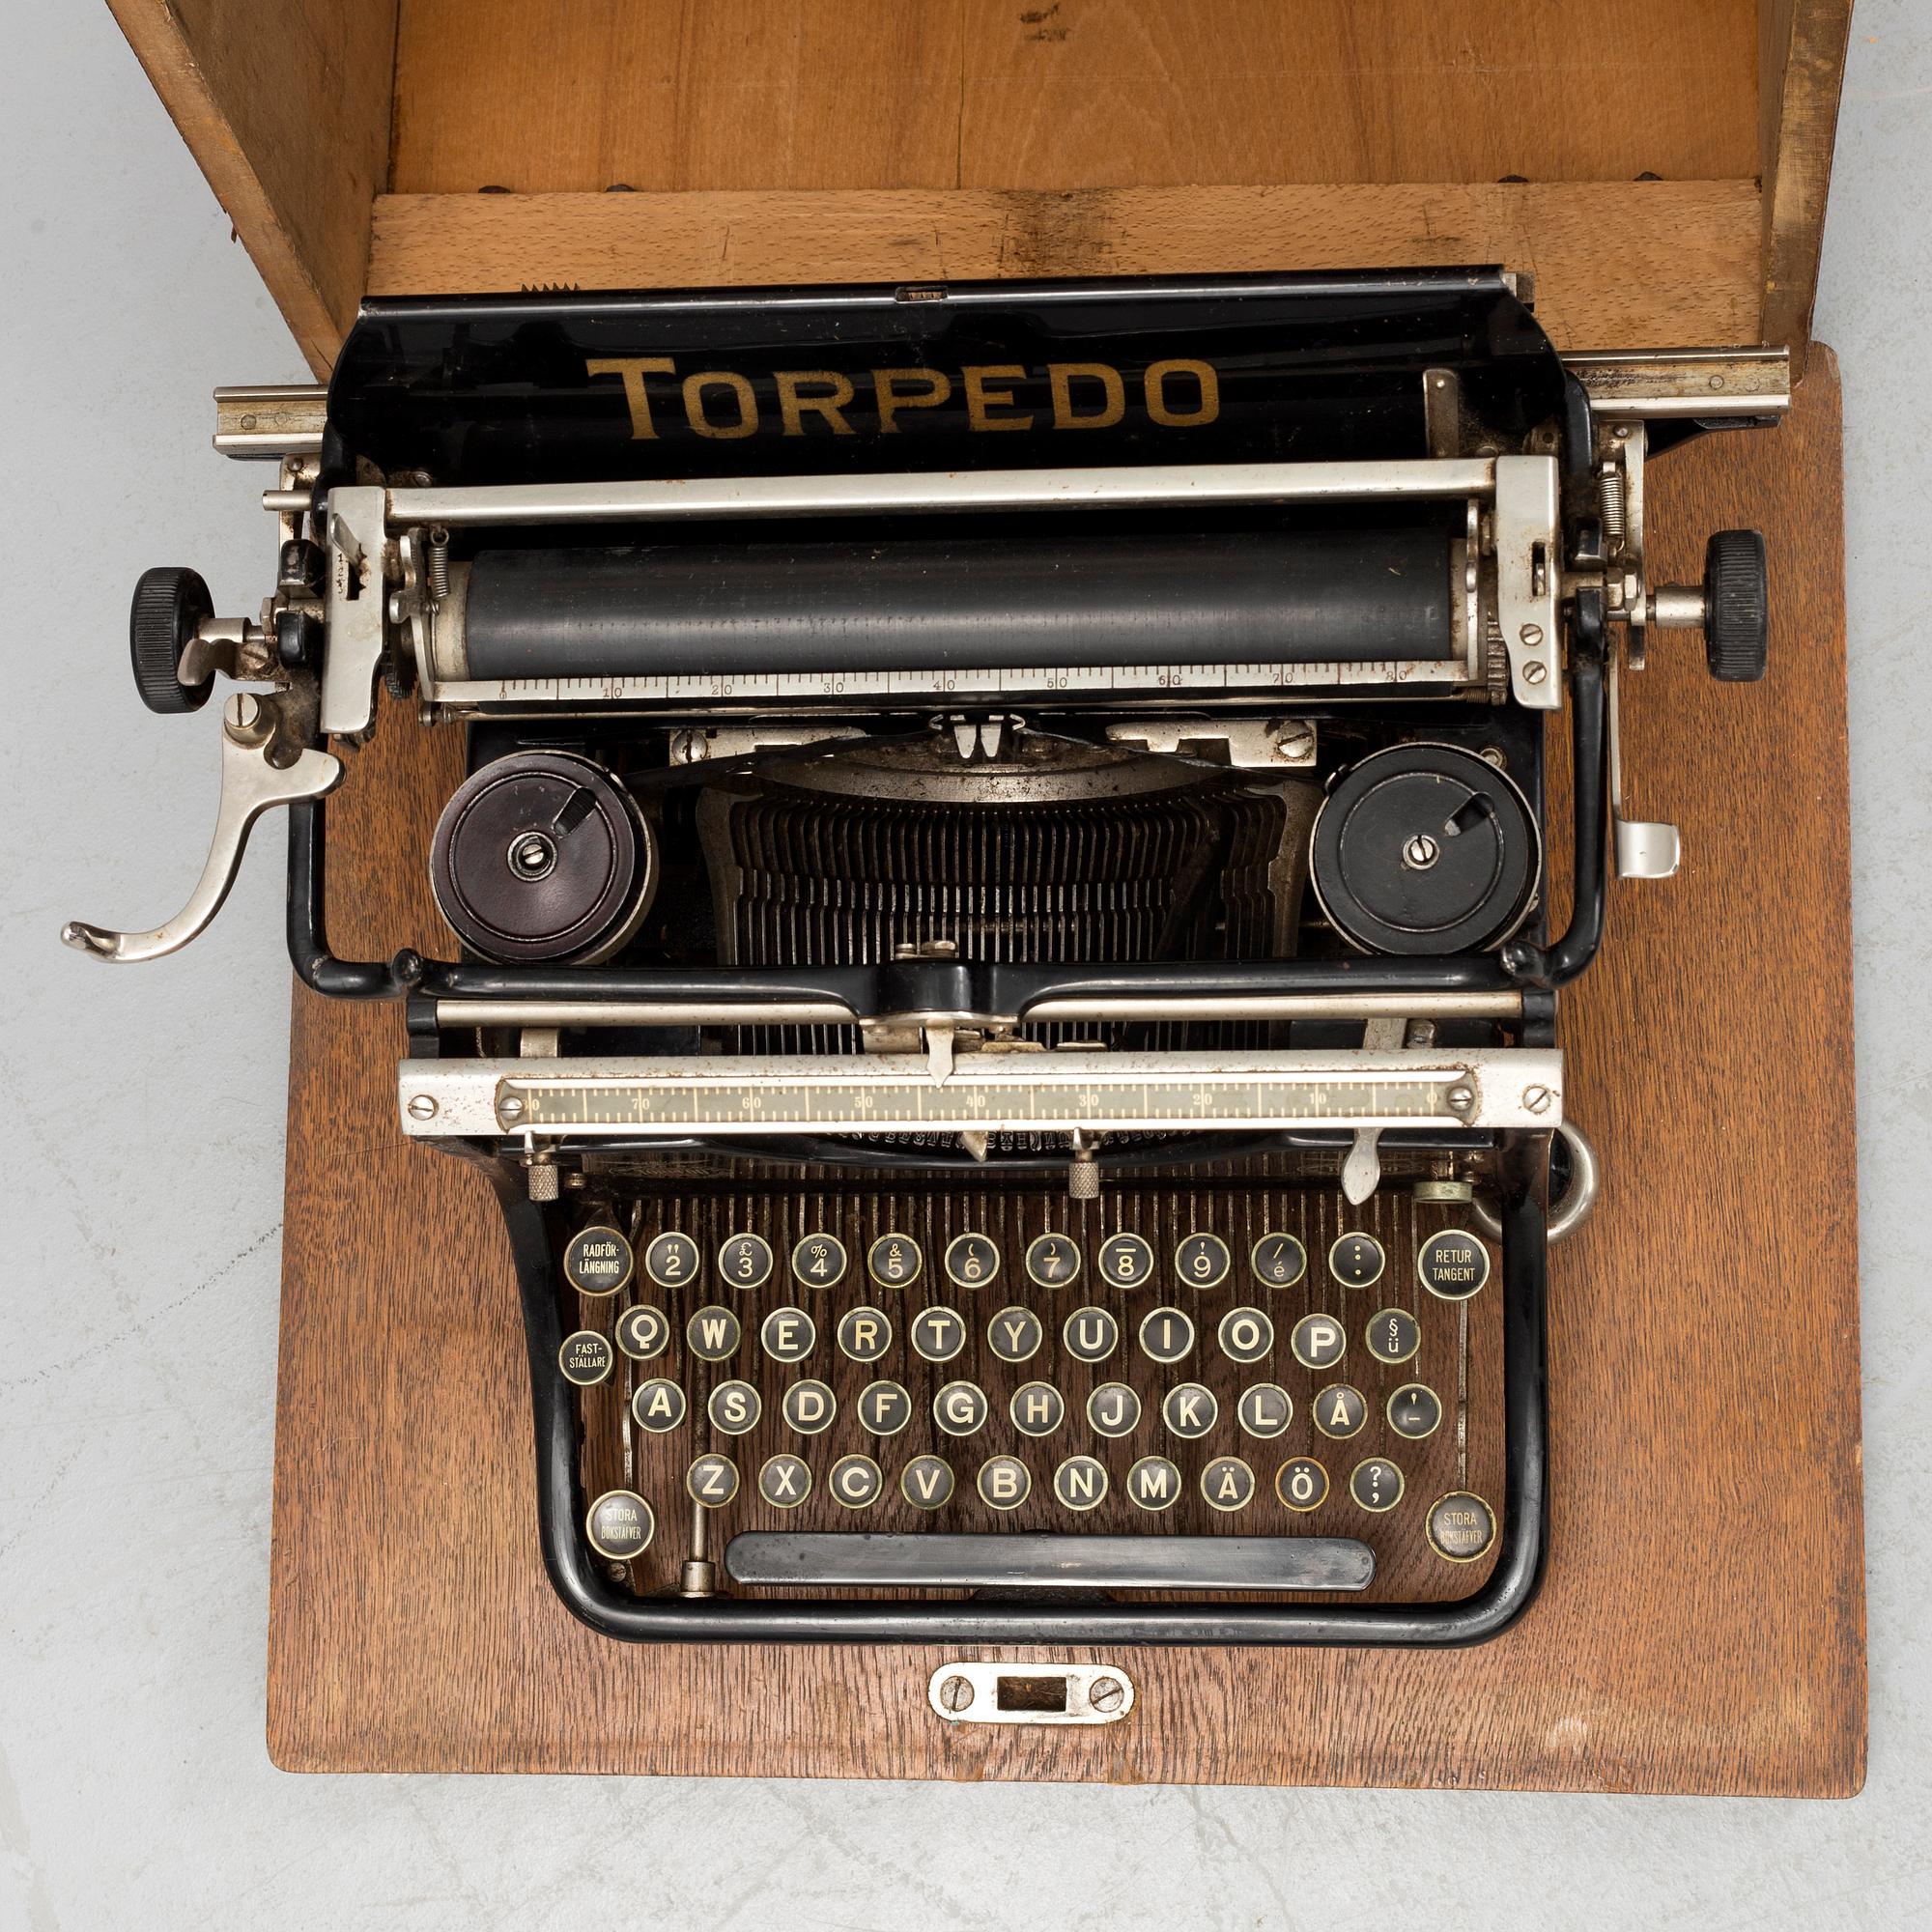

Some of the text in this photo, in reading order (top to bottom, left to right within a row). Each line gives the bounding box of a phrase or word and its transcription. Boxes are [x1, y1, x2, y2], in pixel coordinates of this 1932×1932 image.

[585, 357, 1220, 440] TORPEDO
[602, 687, 623, 697] 10
[711, 685, 732, 696] 20
[823, 682, 844, 694] 30
[933, 679, 955, 691] 40
[1046, 678, 1067, 689] 50
[1158, 674, 1181, 686] 60
[1273, 672, 1293, 684] 70
[1385, 670, 1407, 681] 80
[632, 1096, 650, 1110] 70
[742, 1096, 762, 1110] 60
[854, 1095, 873, 1109] 50
[966, 1095, 985, 1108] 40
[1079, 1094, 1099, 1108] 30
[1192, 1093, 1212, 1107] 20
[1308, 1092, 1326, 1105] 10
[582, 1243, 619, 1258] RADFÖR-
[1436, 1249, 1471, 1264] RETUR
[579, 1259, 619, 1274] LÄNGNING
[666, 1257, 680, 1276] 2
[738, 1259, 753, 1277] 3
[810, 1259, 828, 1277] 4
[888, 1259, 903, 1278] 5
[965, 1260, 980, 1278] 6
[1044, 1259, 1061, 1278] 7
[1118, 1256, 1134, 1277] 8
[1194, 1257, 1211, 1277] 9
[1274, 1262, 1285, 1277] é
[1433, 1267, 1474, 1281] TANGENT
[632, 1316, 657, 1349] Q
[702, 1320, 725, 1349] W
[779, 1321, 799, 1350] E
[855, 1321, 877, 1350] R
[928, 1321, 950, 1349] T
[1004, 1322, 1025, 1351] Y
[1080, 1321, 1102, 1350] U
[1164, 1320, 1170, 1349] I
[1233, 1321, 1259, 1350] O
[1311, 1327, 1335, 1357] P
[1388, 1337, 1399, 1352] ü
[570, 1355, 606, 1369] STÄLLARE
[576, 1344, 602, 1354] FAST-
[648, 1388, 671, 1416] A
[724, 1392, 746, 1422] S
[799, 1392, 824, 1420] D
[876, 1395, 897, 1422] F
[947, 1394, 973, 1424] G
[1028, 1395, 1047, 1423] H
[1101, 1396, 1122, 1425] J
[1179, 1397, 1201, 1427] K
[1255, 1396, 1277, 1425] L
[1331, 1393, 1350, 1425] Å
[702, 1466, 724, 1494] Z
[776, 1466, 795, 1495] X
[842, 1467, 868, 1497] C
[916, 1470, 939, 1499] V
[994, 1469, 1015, 1497] B
[1070, 1469, 1093, 1497] N
[1142, 1469, 1166, 1498] M
[1219, 1467, 1237, 1498] Ä
[1293, 1467, 1312, 1499] Ö
[605, 1508, 637, 1520] STORA
[1444, 1513, 1477, 1524] STORA
